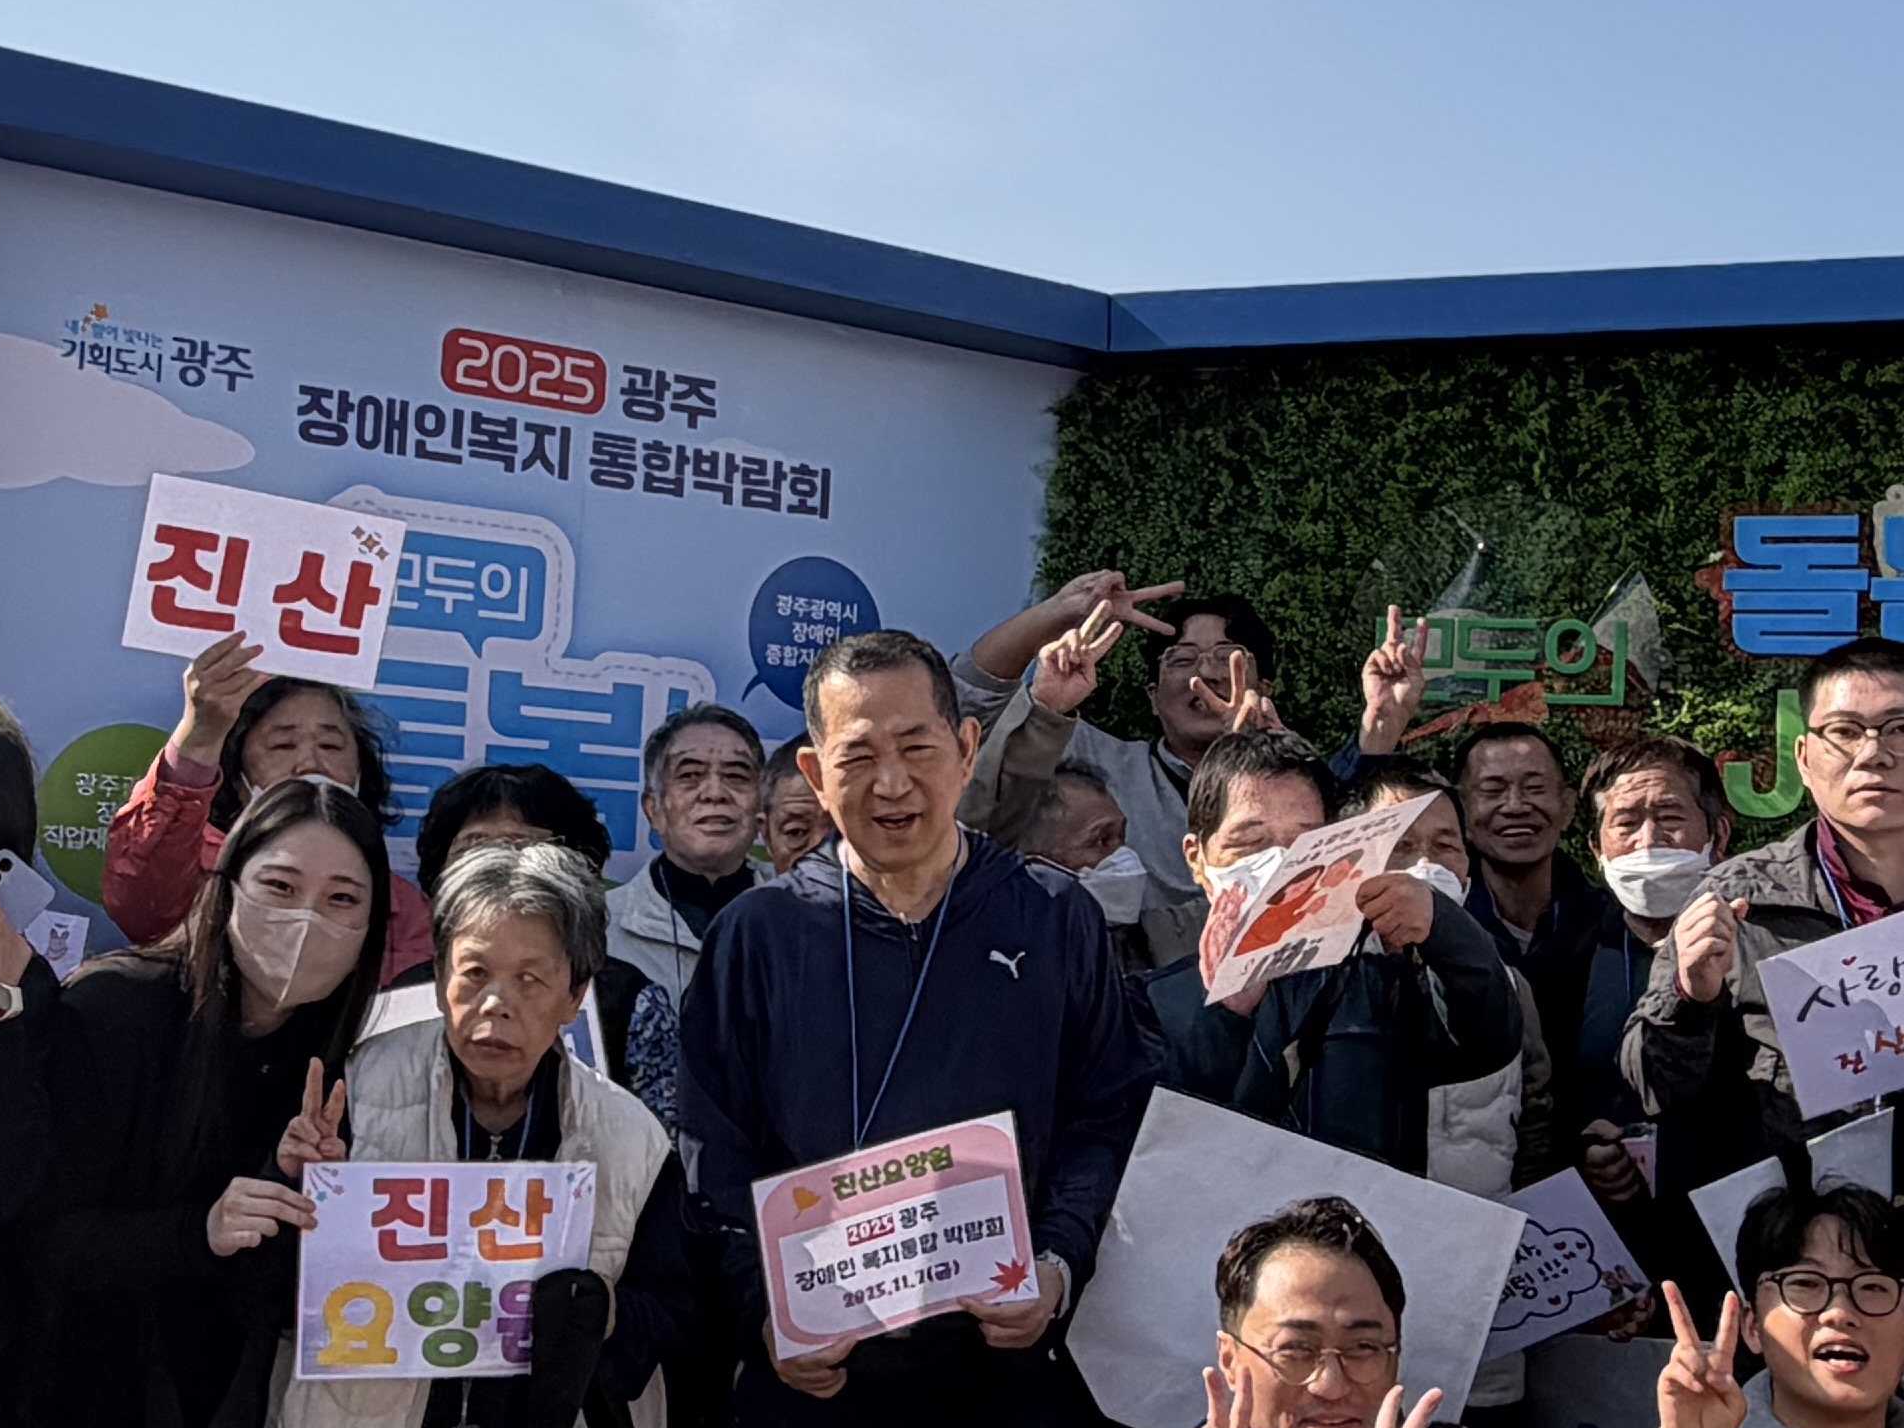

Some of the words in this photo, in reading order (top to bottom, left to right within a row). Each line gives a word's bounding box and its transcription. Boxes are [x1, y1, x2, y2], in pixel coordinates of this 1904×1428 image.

[61, 338, 163, 383] 기회도시
[170, 336, 254, 392] 광주
[454, 336, 597, 407] 2025
[619, 364, 718, 429] 광주
[296, 384, 572, 482] 장애인복지
[588, 430, 833, 520] 통합박람회
[146, 523, 383, 656] 진산
[776, 594, 859, 625] 광주광역시
[43, 824, 109, 851] 직업재
[830, 1143, 956, 1202] 진산요양원
[370, 1177, 554, 1263] 진산
[847, 1213, 895, 1247] 2025
[897, 1199, 941, 1230] 광주
[794, 1256, 857, 1293] 장애인
[861, 1233, 939, 1271] 복지통합
